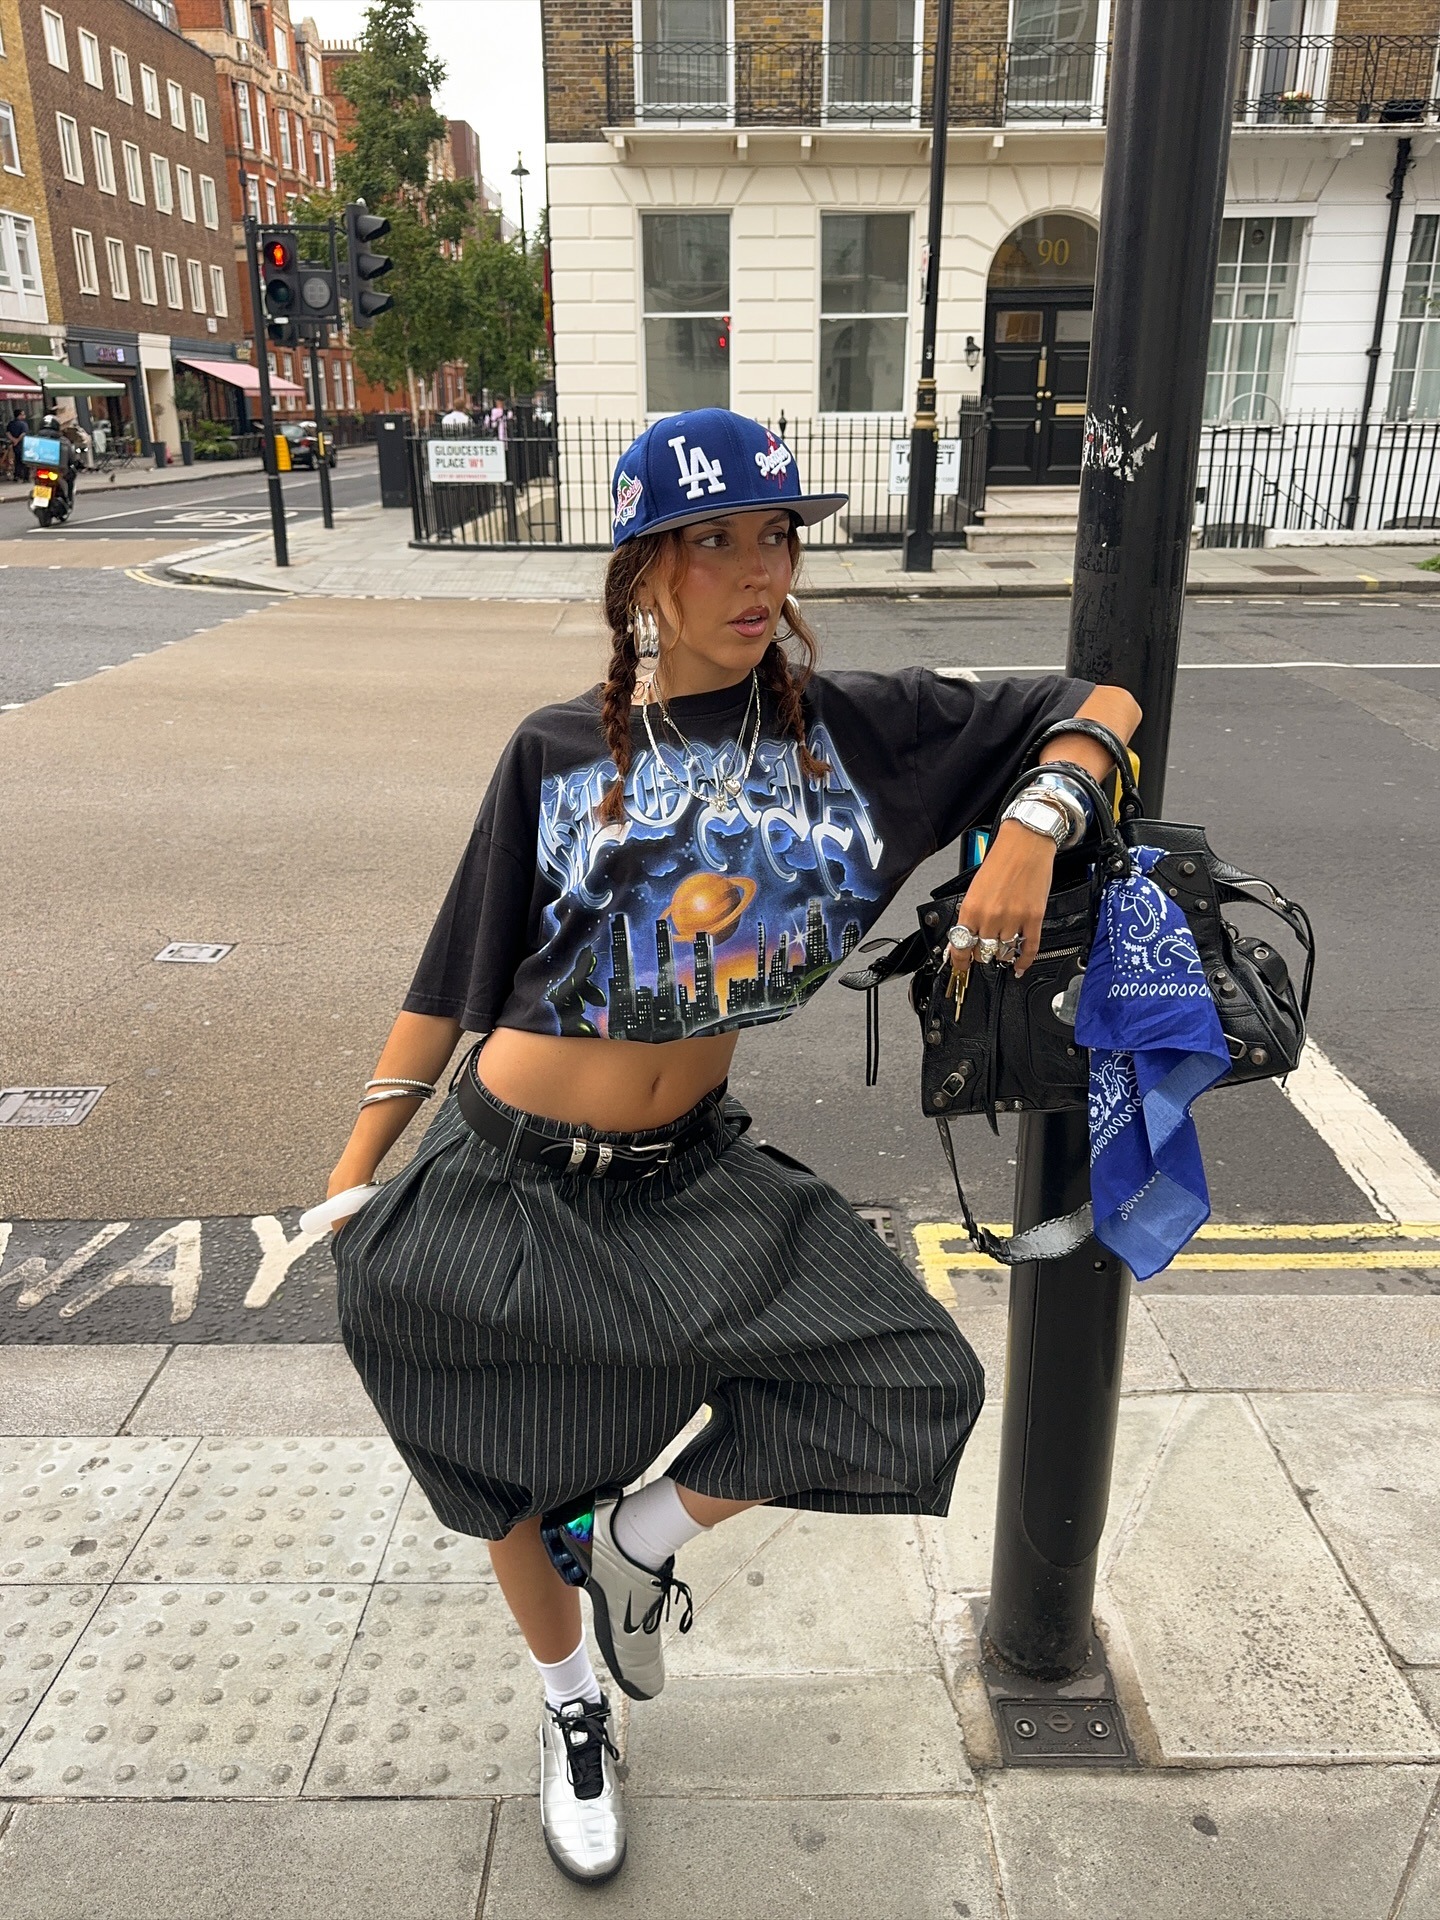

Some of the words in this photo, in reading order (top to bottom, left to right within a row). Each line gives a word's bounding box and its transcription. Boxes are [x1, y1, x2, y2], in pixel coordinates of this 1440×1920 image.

[1038, 239, 1069, 265] 90
[435, 445, 498, 456] GLOUCESTER
[436, 458, 465, 468] PLACE
[468, 458, 484, 468] W1
[936, 452, 955, 465] ET
[668, 436, 726, 500] LA
